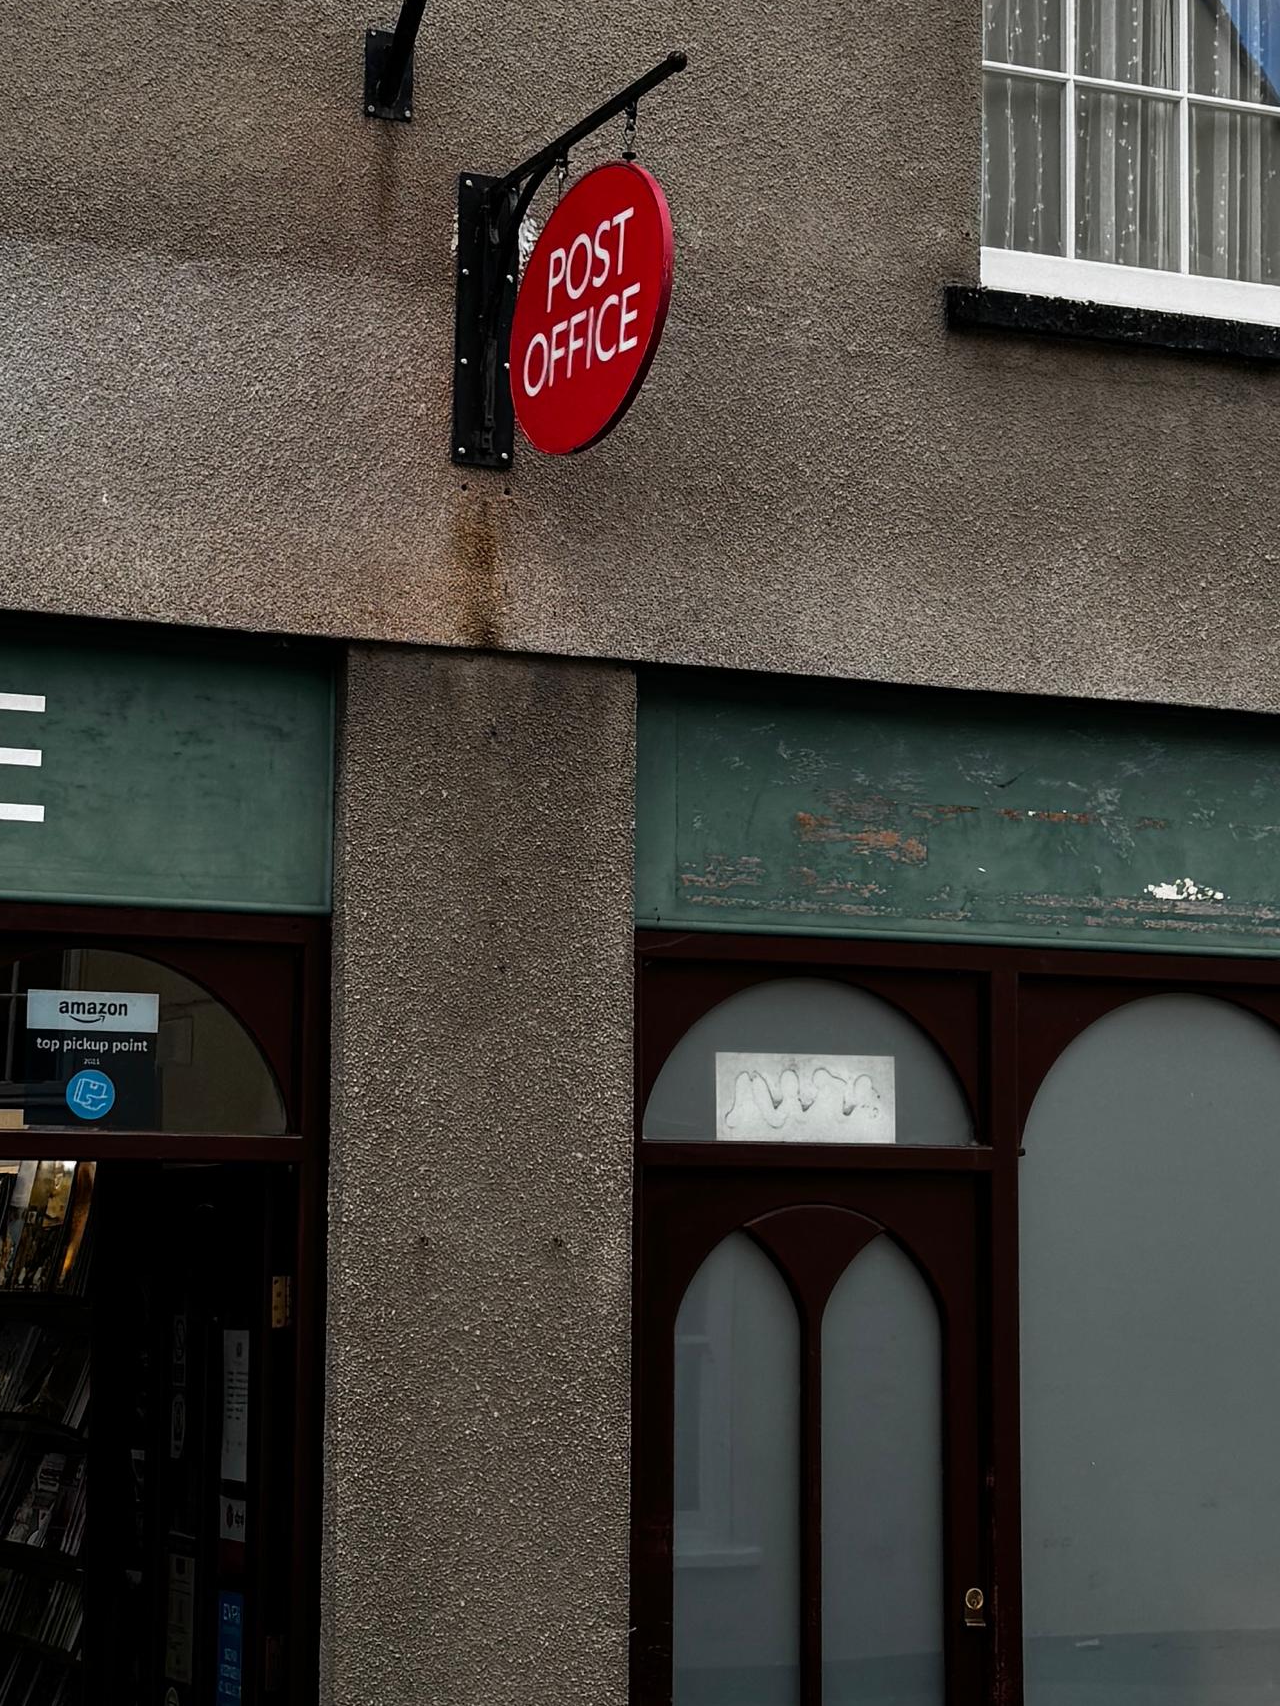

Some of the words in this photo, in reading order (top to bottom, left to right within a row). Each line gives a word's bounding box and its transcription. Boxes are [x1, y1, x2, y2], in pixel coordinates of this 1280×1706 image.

[547, 206, 634, 313] POST
[523, 282, 641, 397] OFFICE
[59, 1000, 128, 1016] amazon
[36, 1037, 60, 1052] top
[63, 1037, 108, 1053] pickup
[112, 1038, 148, 1053] point
